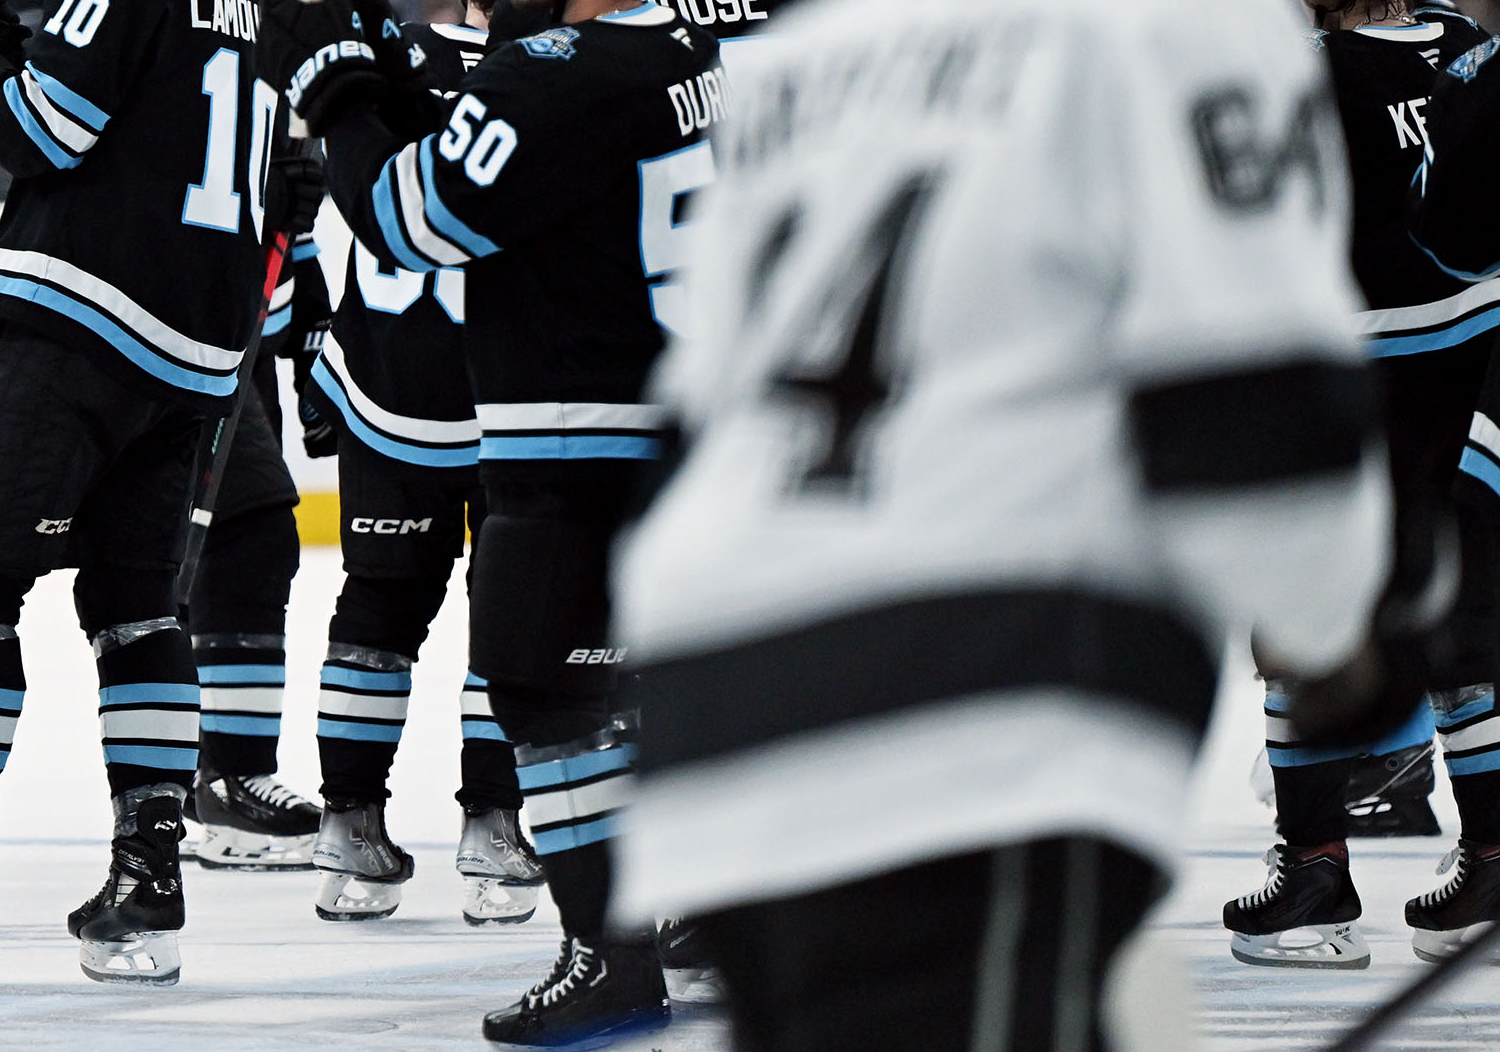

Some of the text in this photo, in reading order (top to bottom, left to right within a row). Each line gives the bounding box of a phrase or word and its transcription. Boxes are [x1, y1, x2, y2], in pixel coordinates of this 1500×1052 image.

[182, 48, 278, 245] 10
[438, 93, 518, 187] 50
[351, 517, 432, 534] CCM
